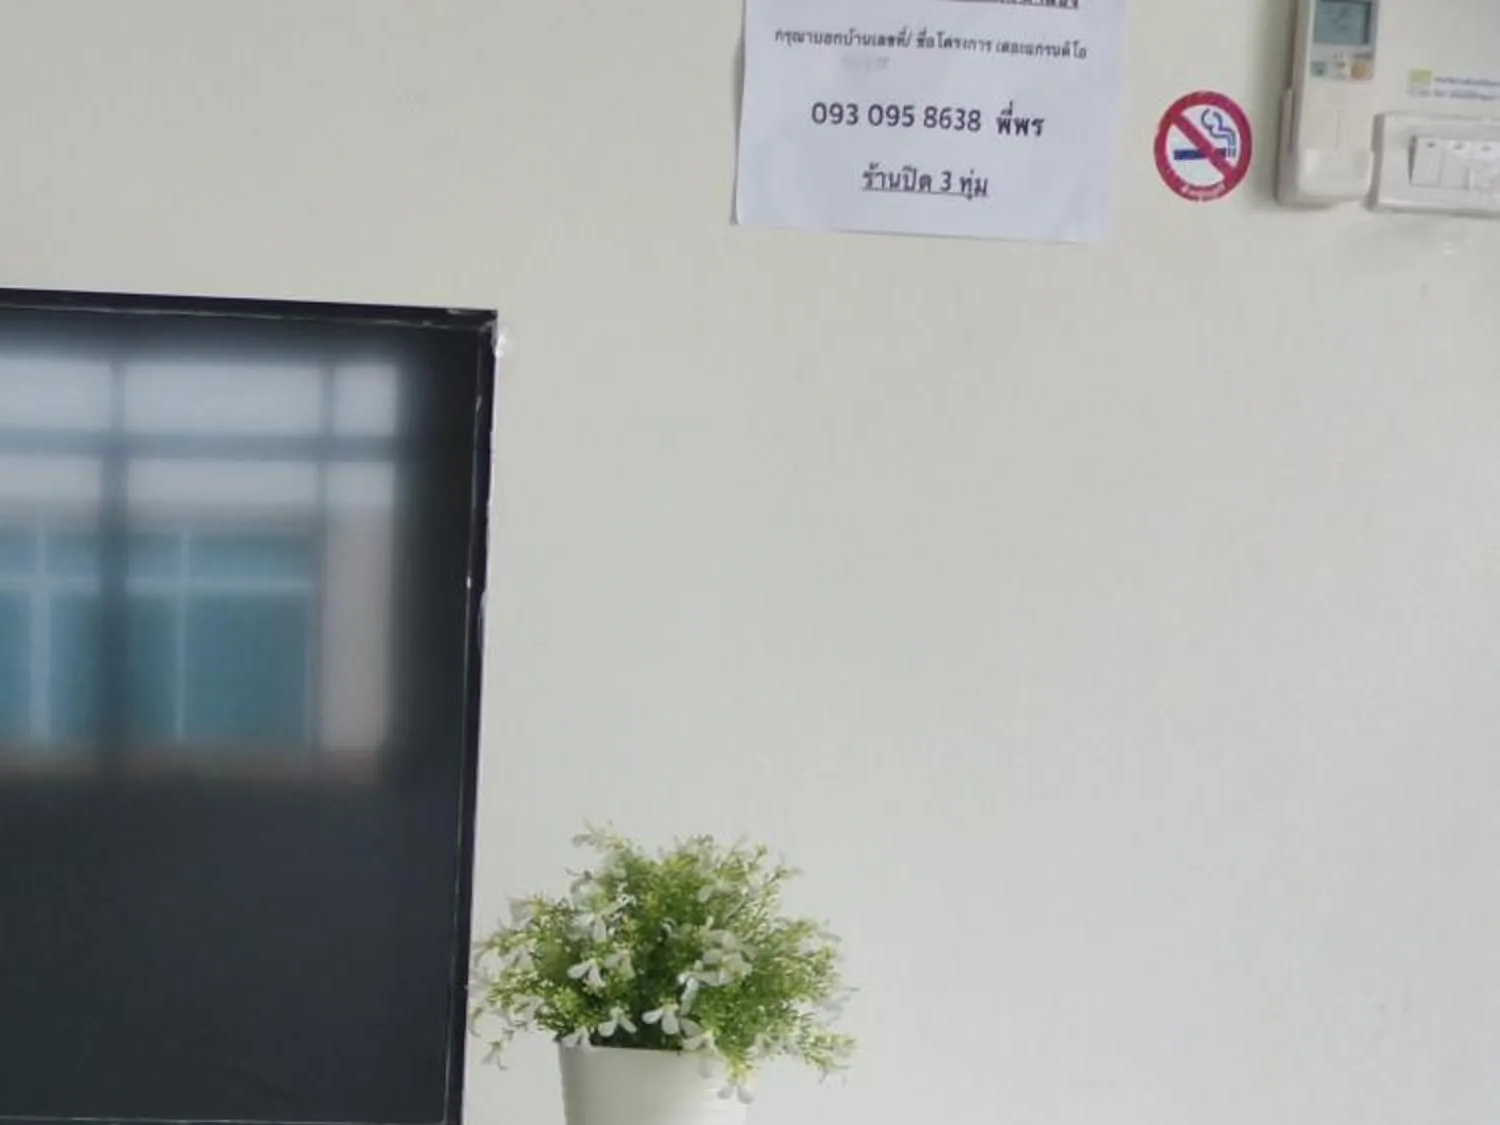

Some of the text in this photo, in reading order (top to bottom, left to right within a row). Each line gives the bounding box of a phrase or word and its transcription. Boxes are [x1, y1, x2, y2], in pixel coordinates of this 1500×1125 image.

[811, 100, 1045, 137] 093 095 8638 พี่พร
[861, 162, 989, 200] ร้านปิด 3 ทุ่ม
